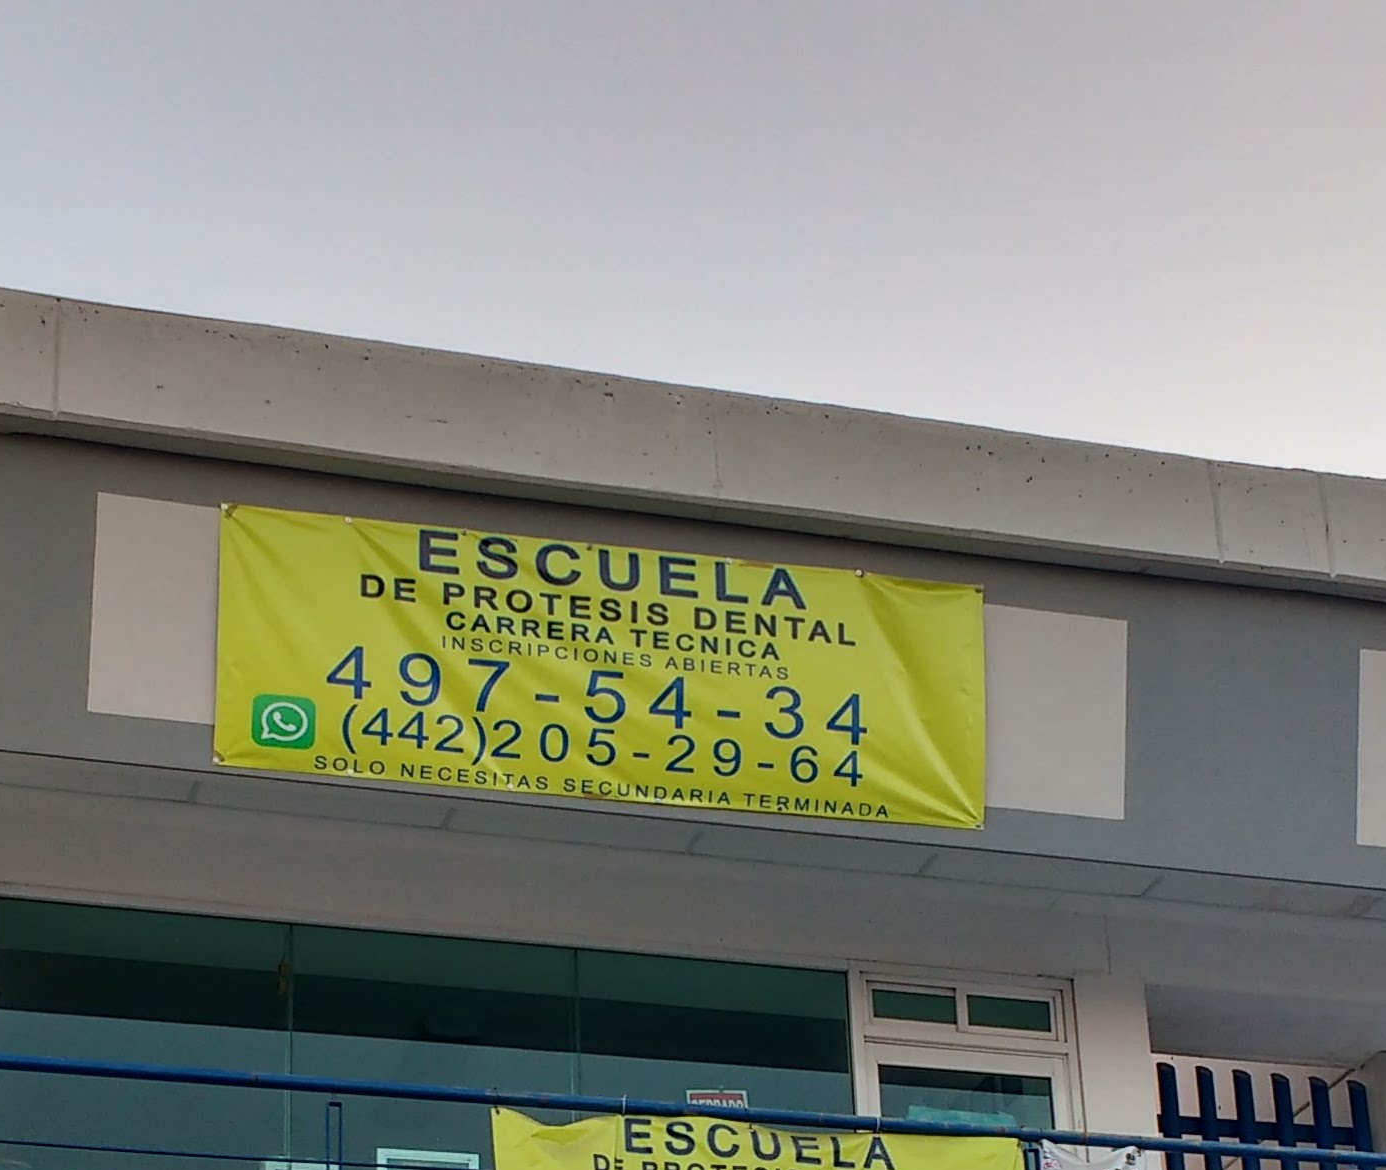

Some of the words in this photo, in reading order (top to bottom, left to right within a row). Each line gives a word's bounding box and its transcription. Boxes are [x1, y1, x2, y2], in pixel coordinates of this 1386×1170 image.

[417, 528, 807, 610] ESCUELA
[359, 573, 418, 605] DE
[441, 581, 671, 626] PROTESIS
[694, 605, 857, 647] DENTAL
[445, 611, 613, 646] CARRERA
[631, 628, 782, 662] TECNICA
[440, 634, 654, 670] INSCRIPCIONES
[665, 654, 791, 681] ABIERTAS
[325, 643, 868, 746] 497-54-34
[313, 754, 386, 777] SOLO
[399, 761, 550, 792] NECESITAS
[563, 776, 732, 808] SECUNDARIA
[742, 792, 890, 820] TERMINADA
